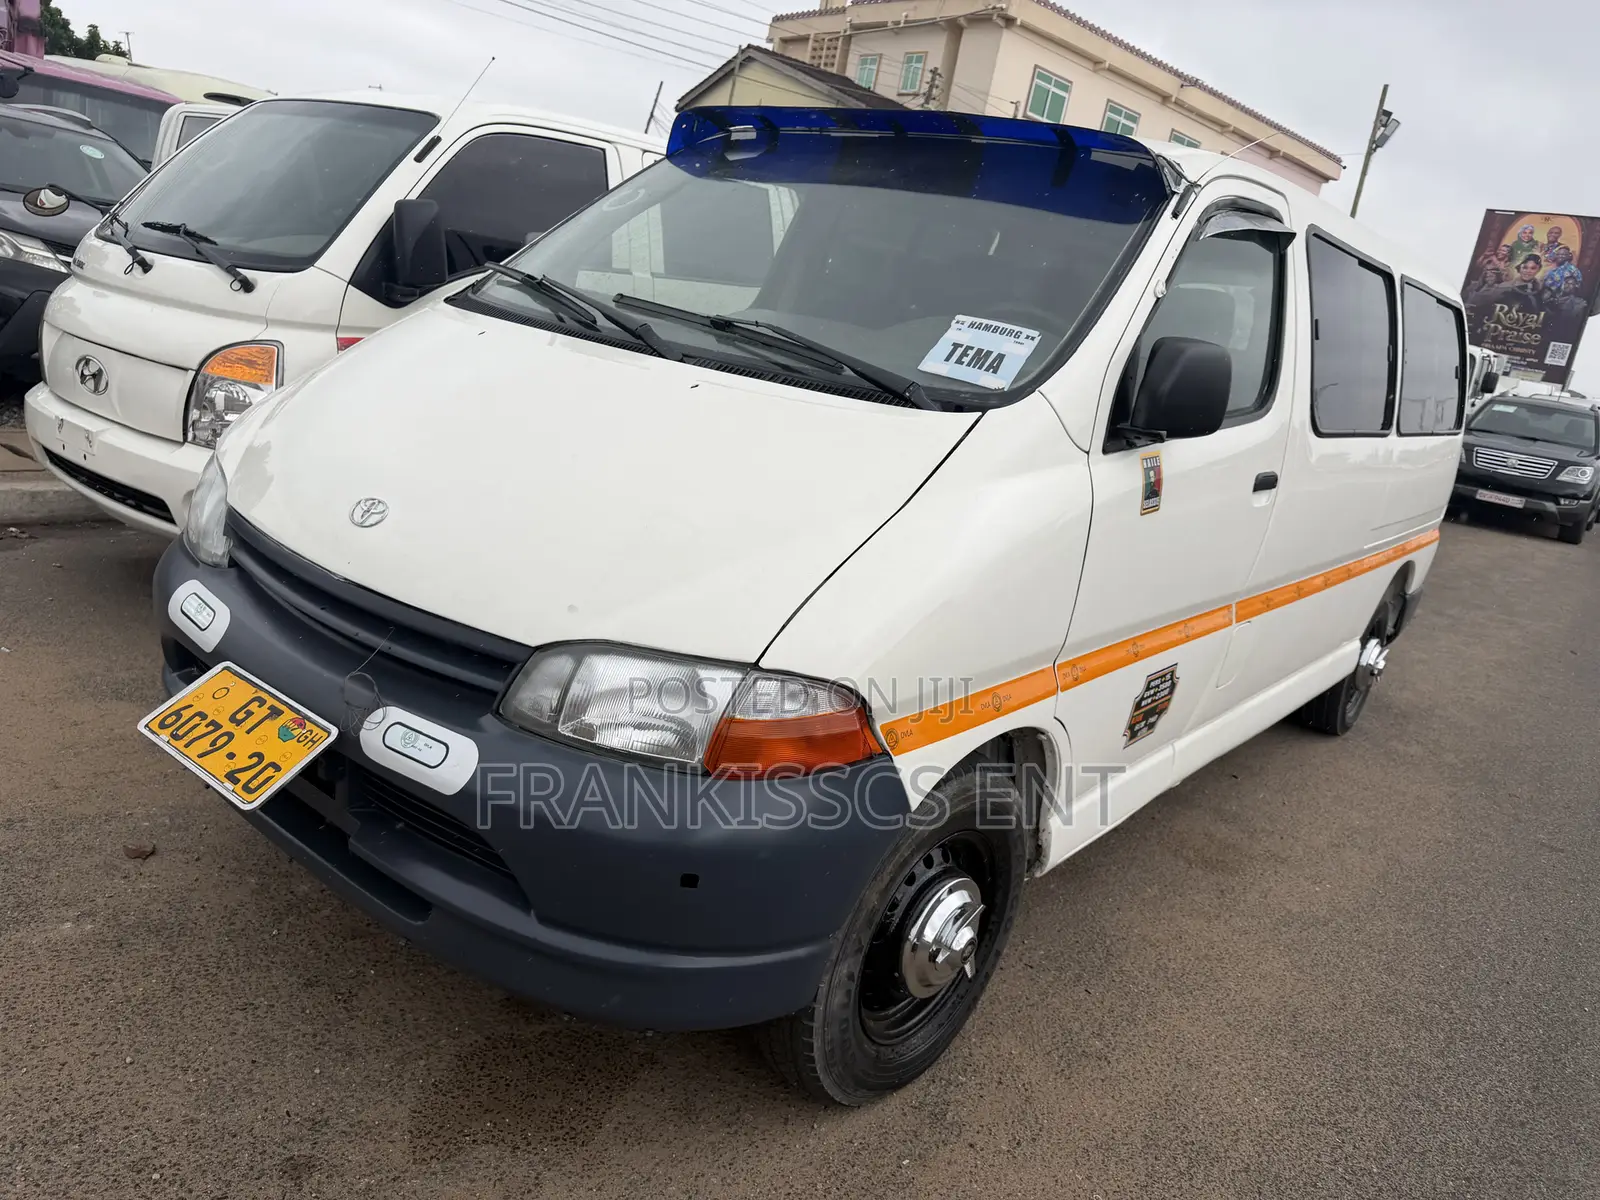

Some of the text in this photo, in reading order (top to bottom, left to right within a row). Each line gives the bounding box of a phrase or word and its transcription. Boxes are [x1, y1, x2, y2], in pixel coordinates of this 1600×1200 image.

[1491, 303, 1546, 329] Royal
[967, 321, 1023, 339] HAMBURG
[1483, 323, 1541, 345] Praise
[943, 341, 1006, 375] TEMA
[228, 695, 285, 735] GT
[296, 729, 324, 750] GH
